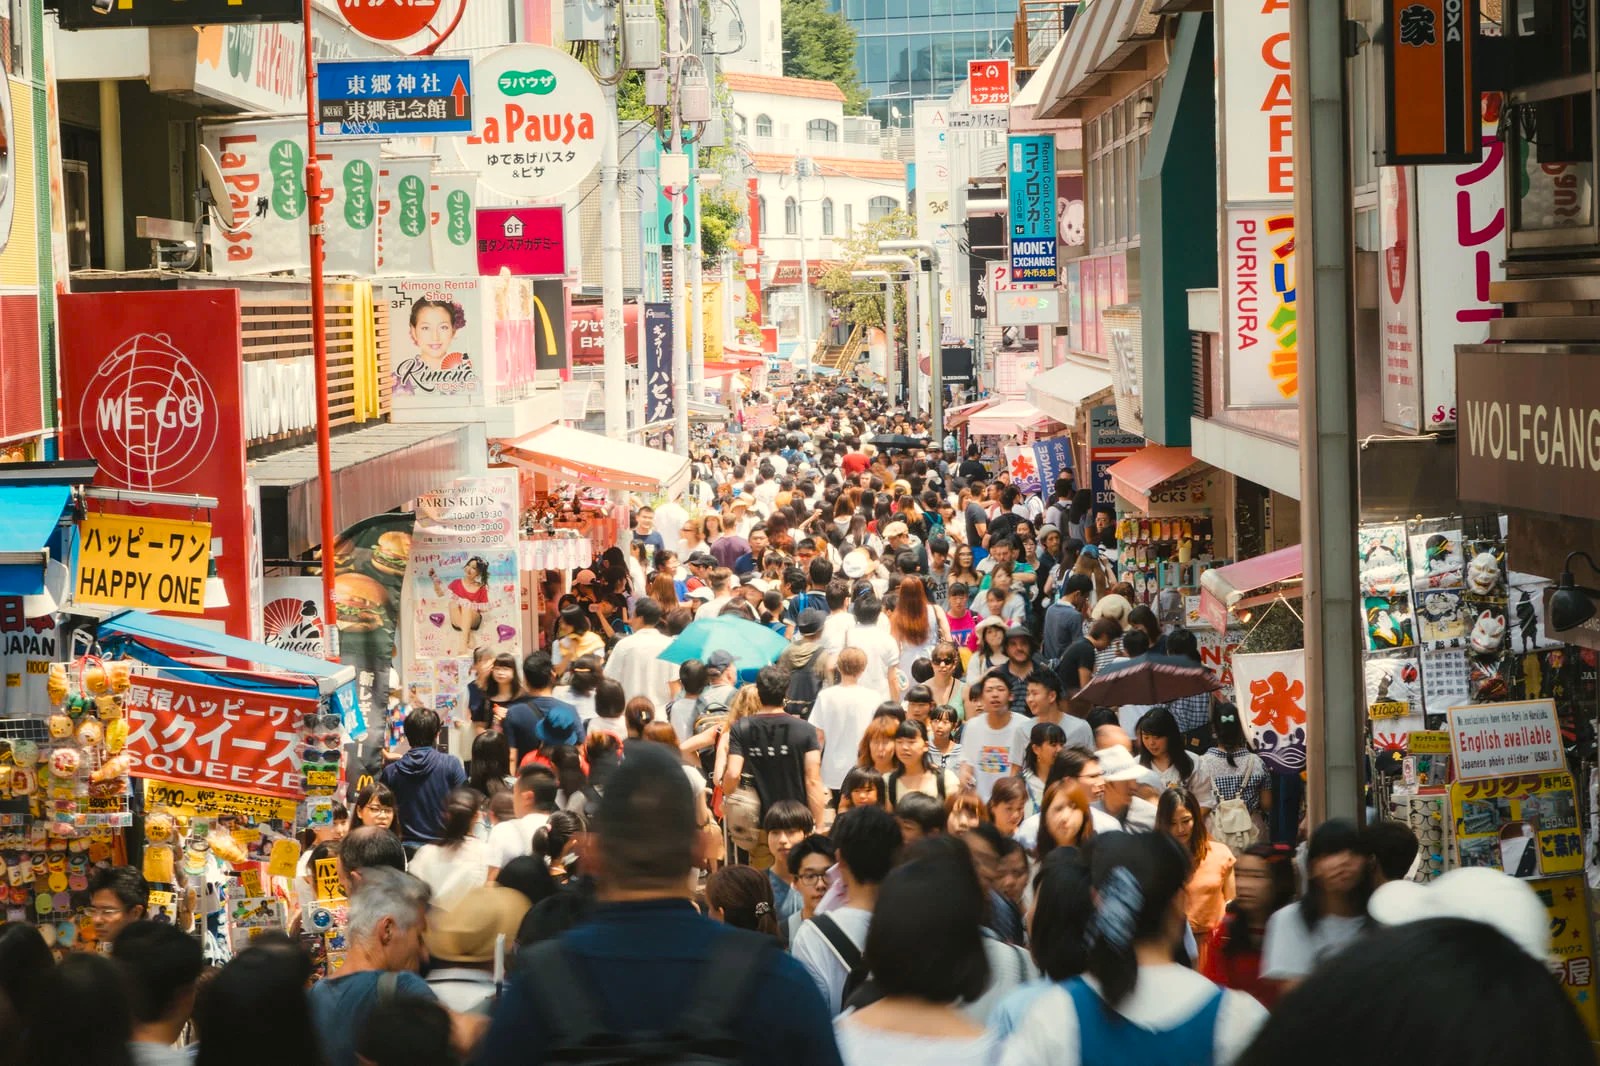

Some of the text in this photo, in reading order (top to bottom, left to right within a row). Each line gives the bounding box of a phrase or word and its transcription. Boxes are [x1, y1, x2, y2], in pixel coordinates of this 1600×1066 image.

[1400, 5, 1436, 46] 家
[345, 72, 442, 95] 東郷神社
[345, 98, 448, 121] 東郷記念館
[979, 93, 1009, 103] アガサ
[505, 103, 594, 145] Pausa
[487, 151, 576, 166] ゆであげパスタ
[1025, 143, 1041, 234] コインロッカー
[506, 224, 520, 233] 6F
[1013, 241, 1055, 255] MONEY
[1013, 257, 1056, 267] EXCHANGE
[400, 280, 477, 290] Kimono Rental
[1236, 220, 1258, 350] PURIKURA
[391, 301, 406, 309] 3F
[426, 291, 453, 303] Shop
[397, 358, 473, 392] Kimono
[1092, 419, 1119, 428] コイン
[1466, 400, 1600, 472] WOLFGANG
[416, 496, 495, 508] PARIS KID'S
[454, 523, 503, 531] 10:00-20:00
[84, 526, 205, 563] ハッピーワン
[80, 566, 202, 605] HAPPY ONE
[3, 635, 55, 656] JAPAN
[1250, 671, 1306, 735] 氷
[1459, 724, 1552, 752] English available
[129, 751, 299, 789] SQUEEZE
[1461, 758, 1486, 770] Japanese
[1488, 757, 1505, 768] photo
[1507, 755, 1529, 766] sticker
[1541, 832, 1582, 858] ご案内
